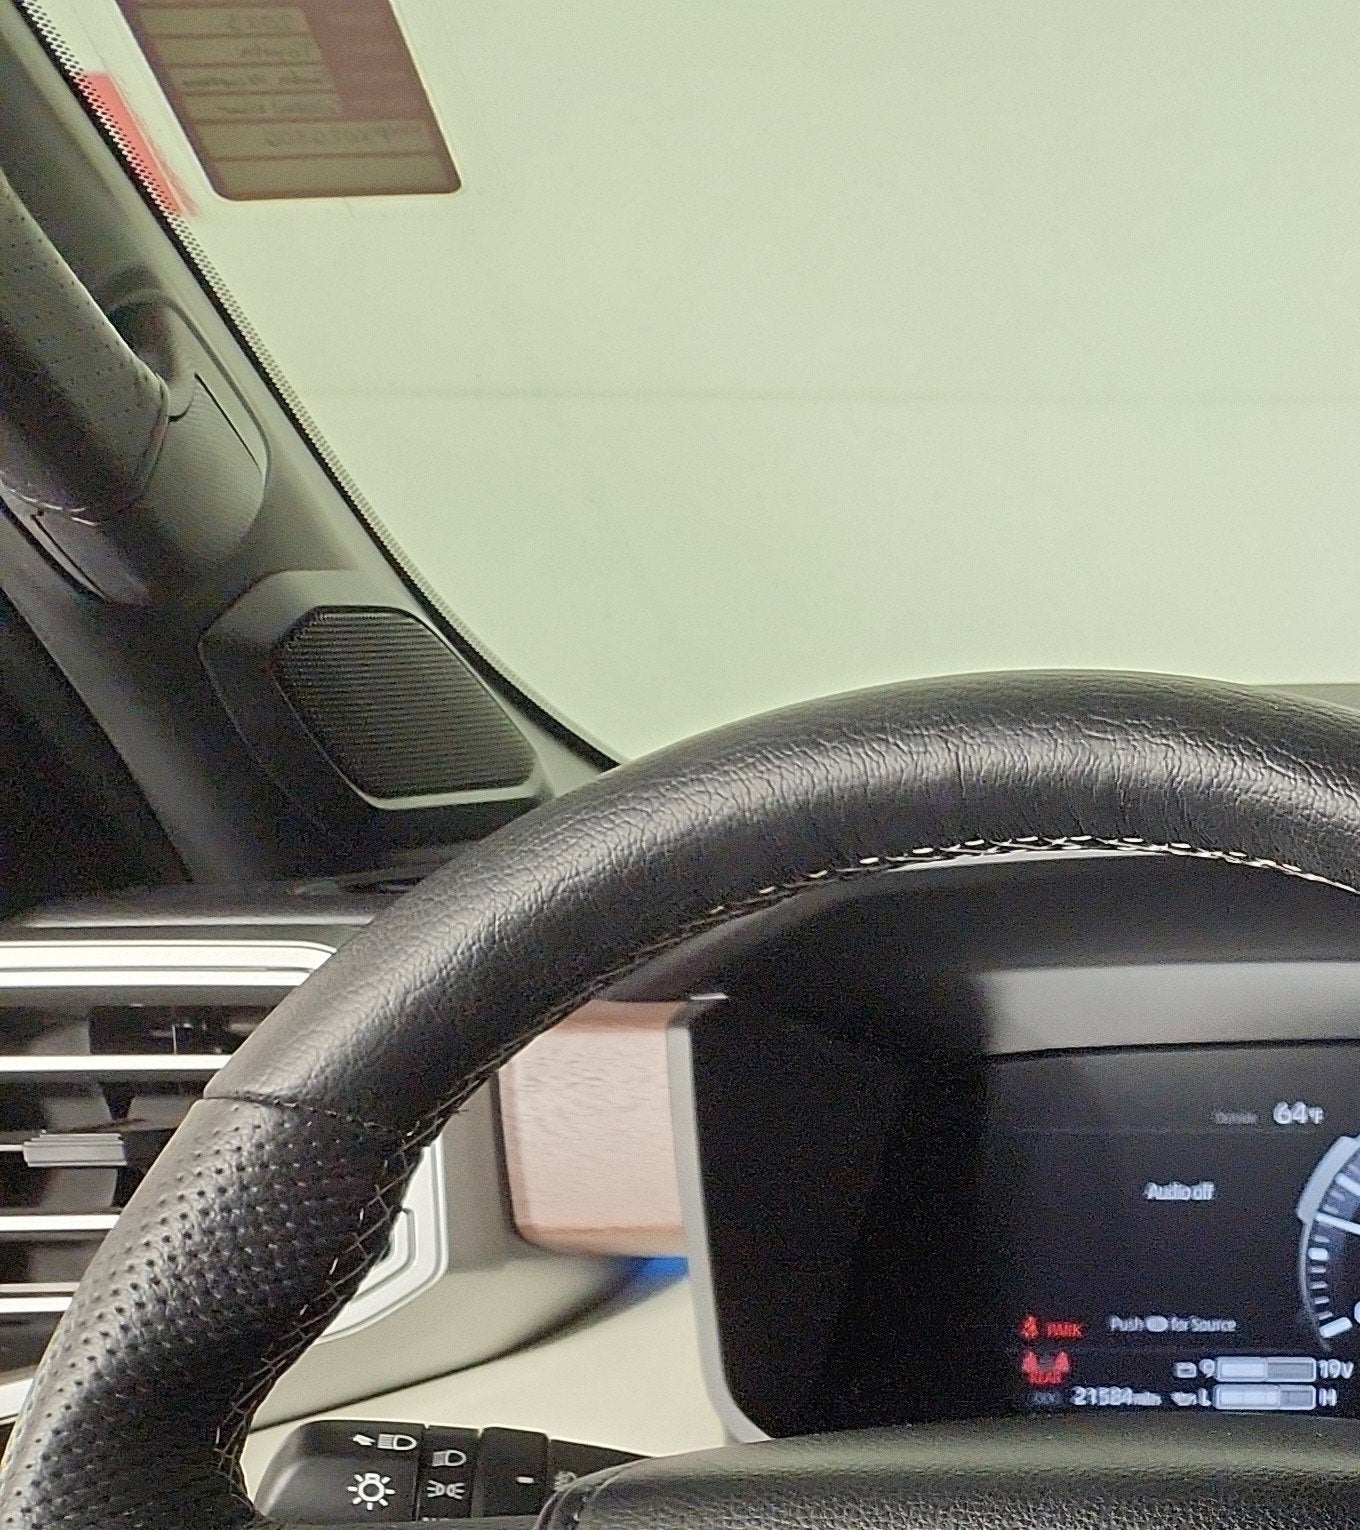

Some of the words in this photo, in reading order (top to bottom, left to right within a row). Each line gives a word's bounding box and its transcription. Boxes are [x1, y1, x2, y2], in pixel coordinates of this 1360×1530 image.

[1143, 1181, 1191, 1201] Audio
[1192, 1181, 1215, 1201] off
[1109, 1315, 1143, 1333] Push
[1170, 1315, 1189, 1332] for
[1190, 1316, 1237, 1333] Source
